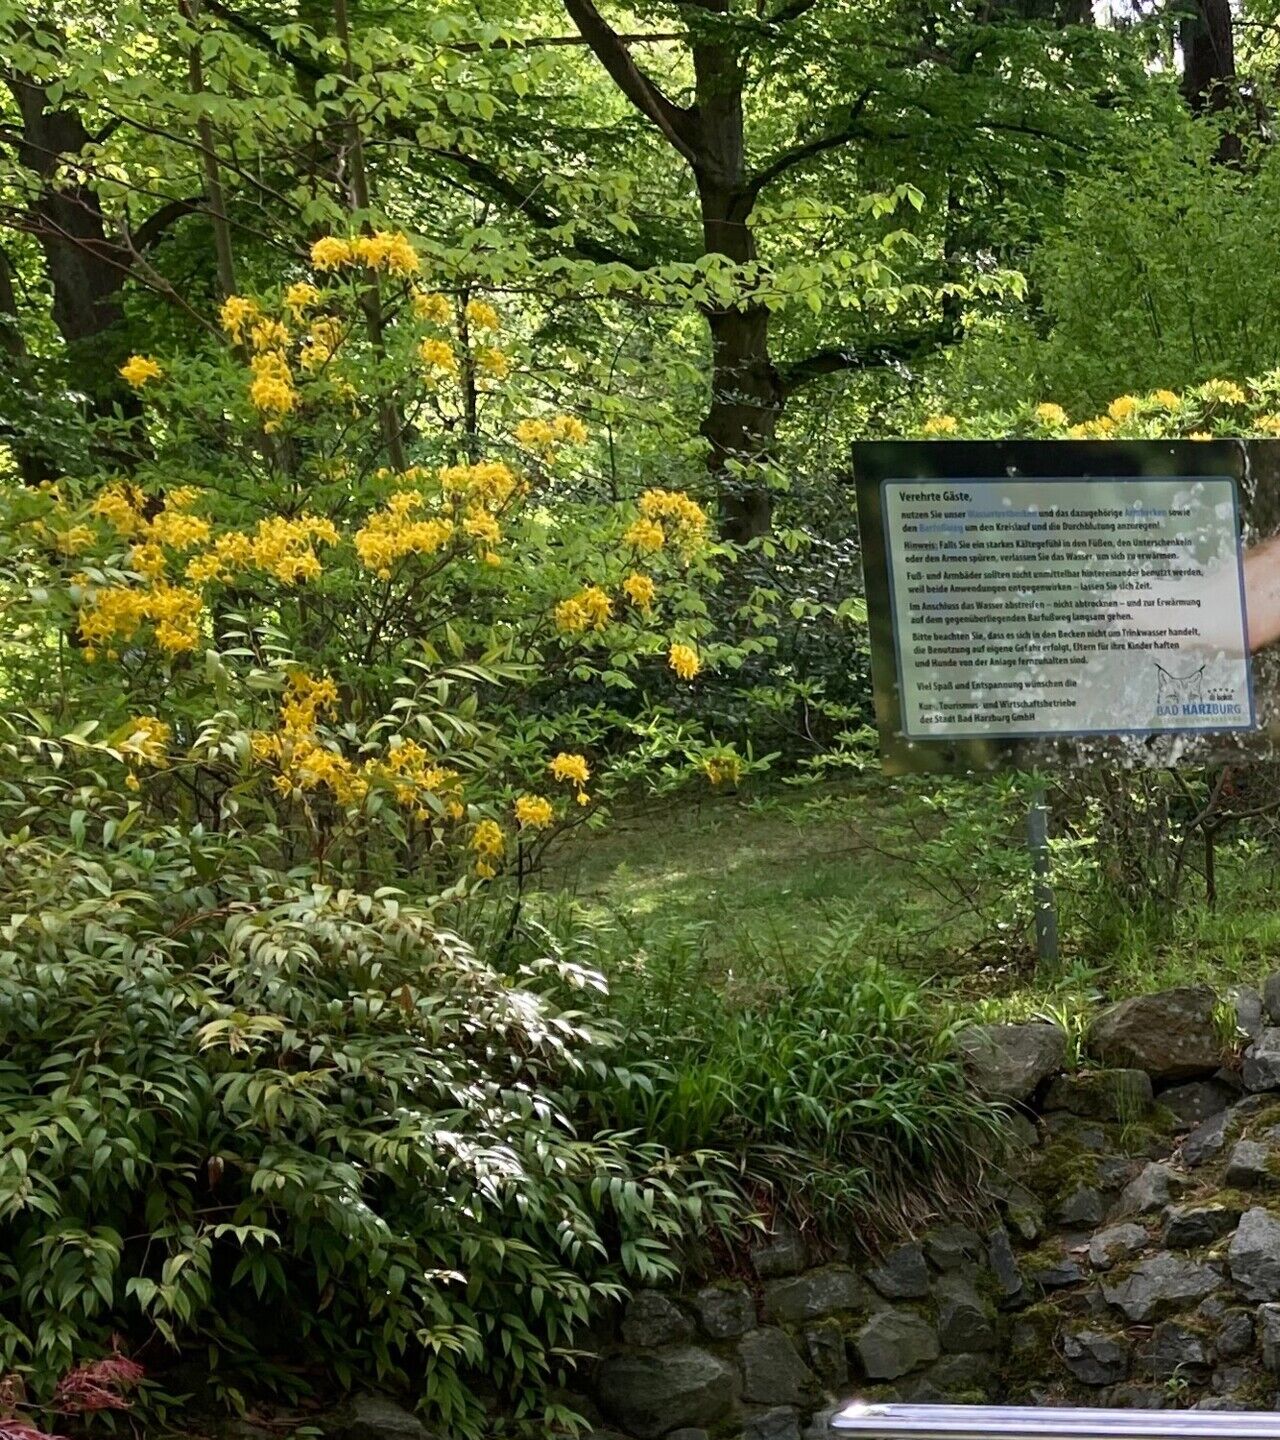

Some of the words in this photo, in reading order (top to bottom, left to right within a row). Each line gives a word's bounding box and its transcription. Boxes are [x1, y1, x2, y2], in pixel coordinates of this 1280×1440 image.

[899, 492, 941, 501] Verehrte
[943, 491, 972, 502] Gäste,
[901, 511, 929, 519] nutzen
[1039, 509, 1054, 517] und
[1055, 509, 1069, 517] das
[1070, 509, 1123, 519] dazugehörige
[1169, 508, 1190, 516] sowie
[902, 524, 918, 532] den
[980, 523, 994, 531] den
[996, 522, 1031, 531] Kreislauf
[1032, 522, 1047, 530] und
[1048, 522, 1060, 530] die
[1062, 521, 1116, 532] Durchblutung
[904, 541, 938, 551] Hinweis:
[940, 541, 958, 549] Falls
[986, 540, 1014, 548] starkes
[1015, 540, 1062, 550] Kältegefühl
[1063, 539, 1070, 547] in
[1072, 539, 1086, 547] den
[1132, 538, 1192, 546] Unterschenkeln
[942, 554, 968, 562] Armen
[969, 554, 999, 564] spüren,
[1000, 553, 1036, 561] verlassen
[1038, 553, 1050, 561] Sie
[1110, 552, 1126, 560] sich
[907, 572, 924, 580] Fuß-
[983, 571, 1010, 579] sollten
[1033, 570, 1080, 578] unmittelbar
[1081, 570, 1139, 578] hintereinander
[1141, 569, 1171, 577] benutzt
[926, 585, 948, 593] beide
[950, 584, 1006, 595] Anwendungen
[1008, 583, 1072, 594] entgegenwirken
[1080, 582, 1105, 590] lassen
[1106, 582, 1118, 590] Sie
[910, 602, 920, 610] Im
[922, 602, 960, 610] Anschluss
[976, 601, 1003, 609] Wasser
[1005, 601, 1044, 609] abstreifen
[1053, 600, 1073, 608] nicht
[1127, 599, 1142, 607] und
[1157, 598, 1201, 608] Erwärmung
[911, 616, 924, 624] auf
[926, 615, 943, 623] dem
[945, 614, 1026, 625] gegenüberliegenden
[1028, 613, 1071, 624] Barfußweg
[1072, 613, 1106, 623] langsam
[1107, 612, 1134, 622] gehen.
[912, 632, 932, 640] Bitte
[933, 632, 970, 640] beachten
[987, 631, 1005, 639] dass
[1016, 631, 1031, 639] sich
[1032, 631, 1040, 639] in
[1058, 630, 1086, 638] Becken
[1087, 630, 1107, 638] nicht
[1122, 629, 1168, 637] Trinkwasser
[1169, 628, 1200, 638] handelt,
[914, 646, 926, 654] die
[928, 645, 970, 656] Benutzung
[972, 645, 986, 653] auf
[987, 644, 1013, 655] eigene
[1015, 644, 1041, 652] Gefahr
[1042, 643, 1072, 653] erfolgt,
[1073, 643, 1096, 651] Eltern
[1110, 642, 1126, 650] ihre
[1128, 642, 1152, 650] Kinder
[1154, 641, 1180, 649] haften
[915, 659, 930, 667] und
[931, 658, 958, 666] Hunde
[975, 658, 988, 666] der
[989, 657, 1016, 667] Anlage
[1018, 656, 1068, 665] fernzuhalten
[1070, 656, 1088, 664] sind.
[916, 682, 932, 690] Viel
[933, 682, 954, 692] Spaß
[955, 681, 970, 689] und
[972, 681, 1024, 691] Entspannung
[1025, 680, 1064, 688] wünschen
[1065, 680, 1078, 688] die
[1000, 700, 1077, 708] Wirtschaftsbetriebe
[1156, 705, 1179, 716] BAD
[1182, 703, 1242, 716] HARZBURG
[920, 715, 932, 723] der
[934, 714, 956, 722] Stadt
[957, 714, 972, 722] Bad
[974, 714, 1011, 724] Harzburg
[1012, 713, 1036, 721] GmbH
